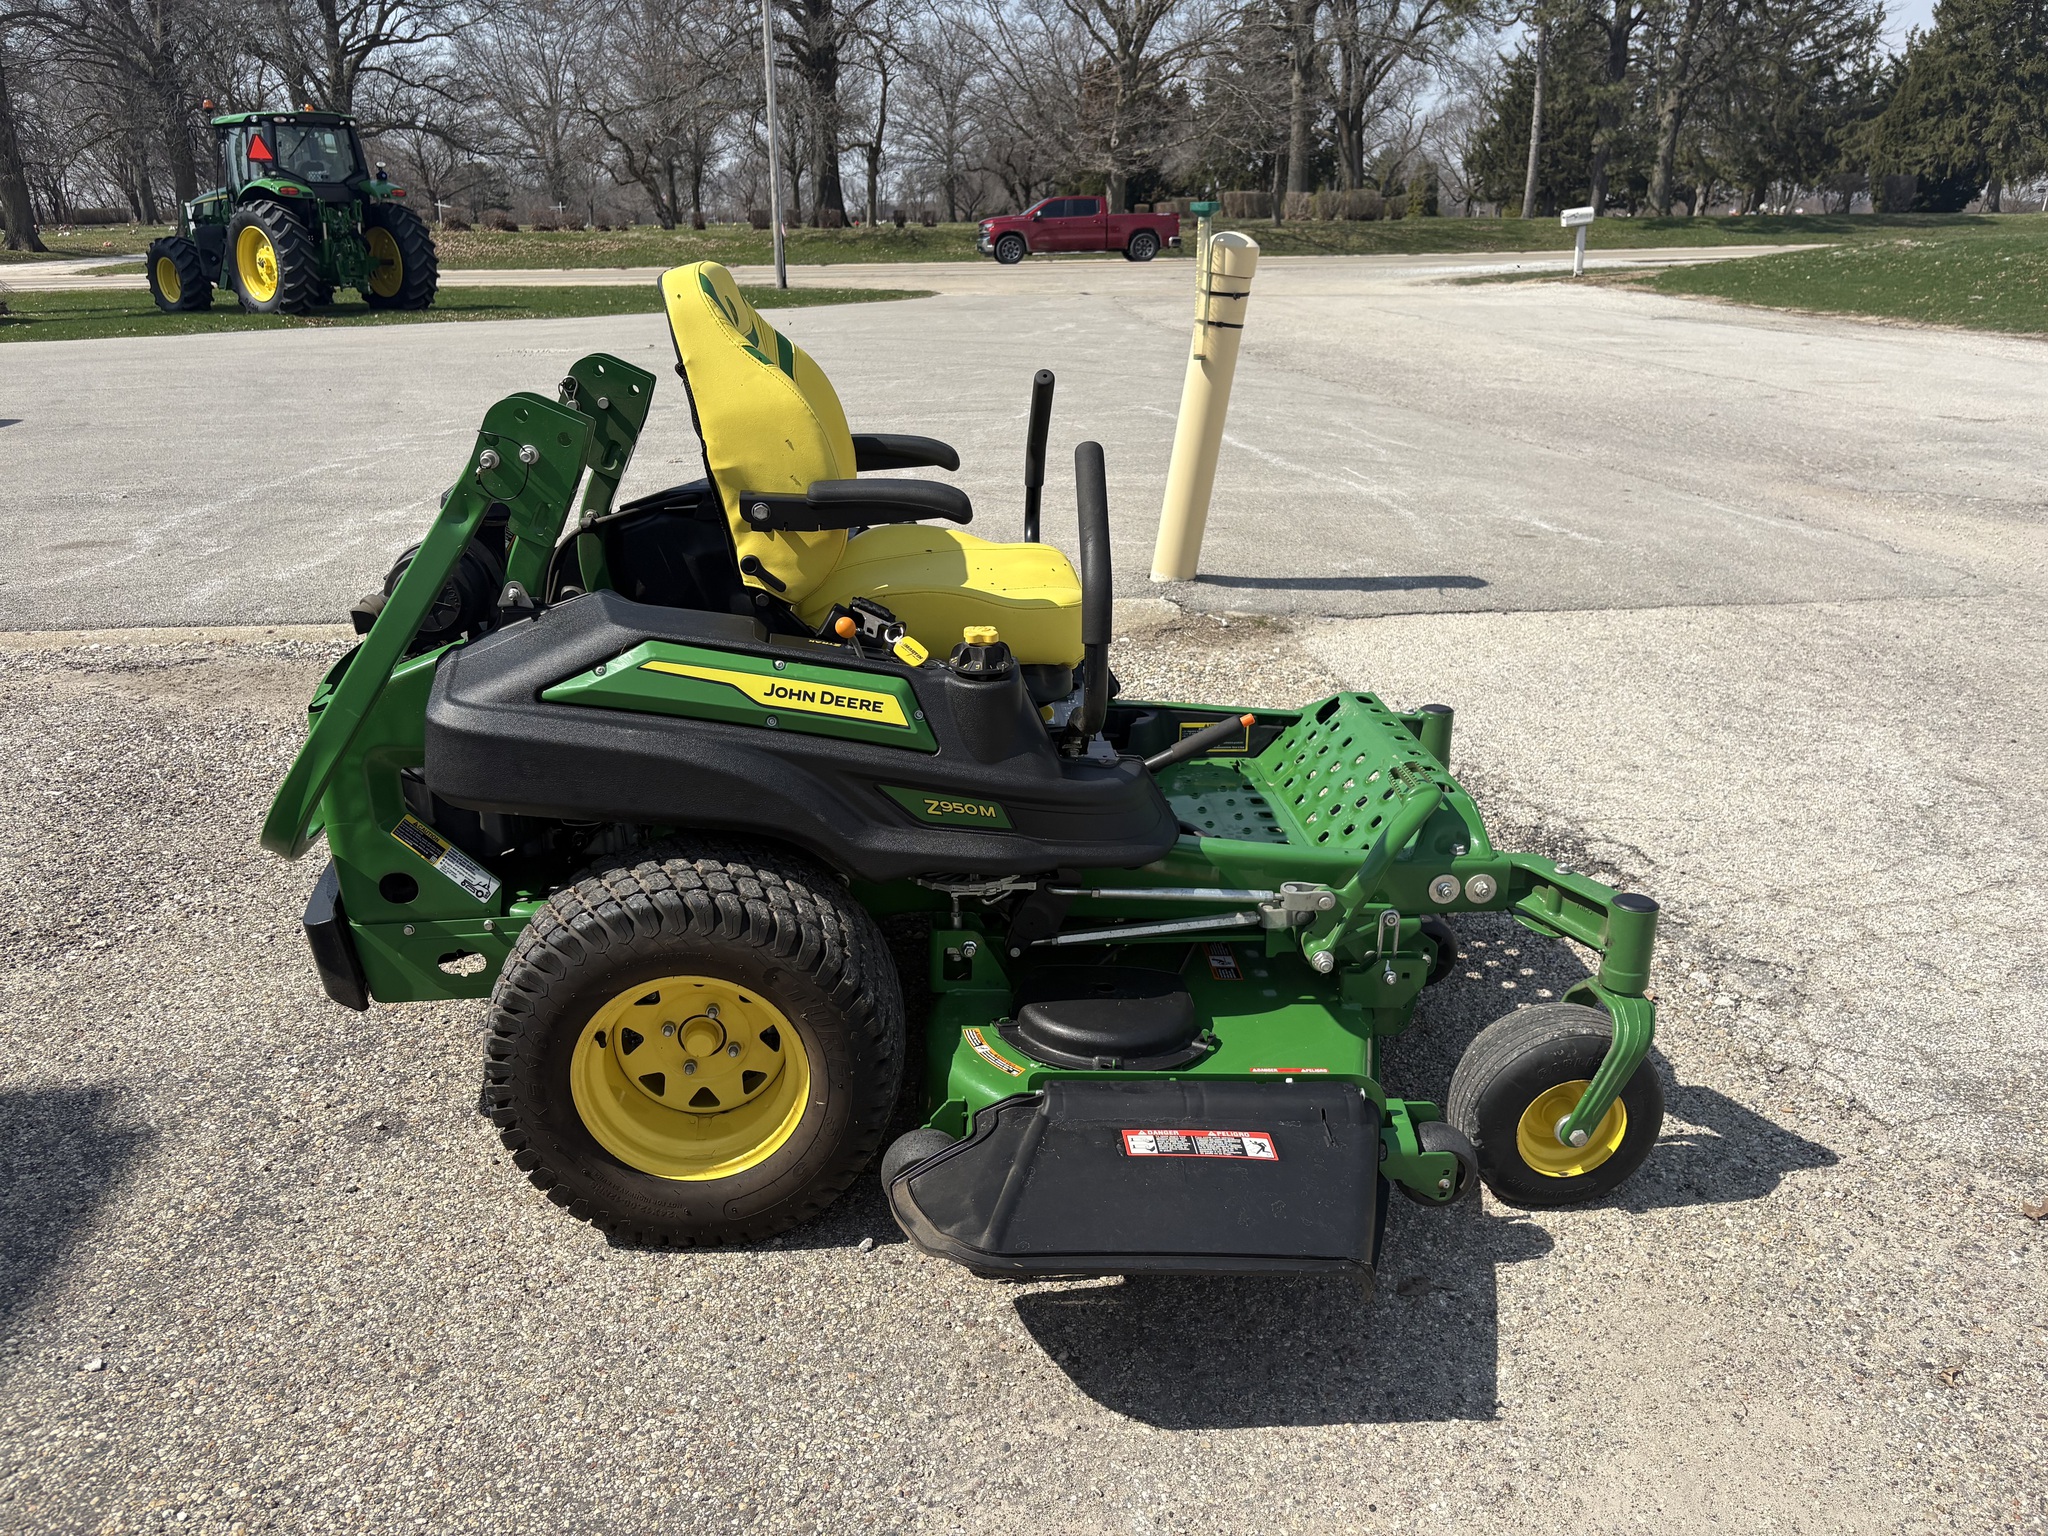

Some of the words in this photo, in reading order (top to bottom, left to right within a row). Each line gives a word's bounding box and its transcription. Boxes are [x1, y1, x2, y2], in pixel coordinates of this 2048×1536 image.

[764, 683, 815, 704] JOHN
[820, 688, 885, 713] DEERE
[923, 799, 998, 820] Z950M
[417, 824, 441, 843] CAUTION
